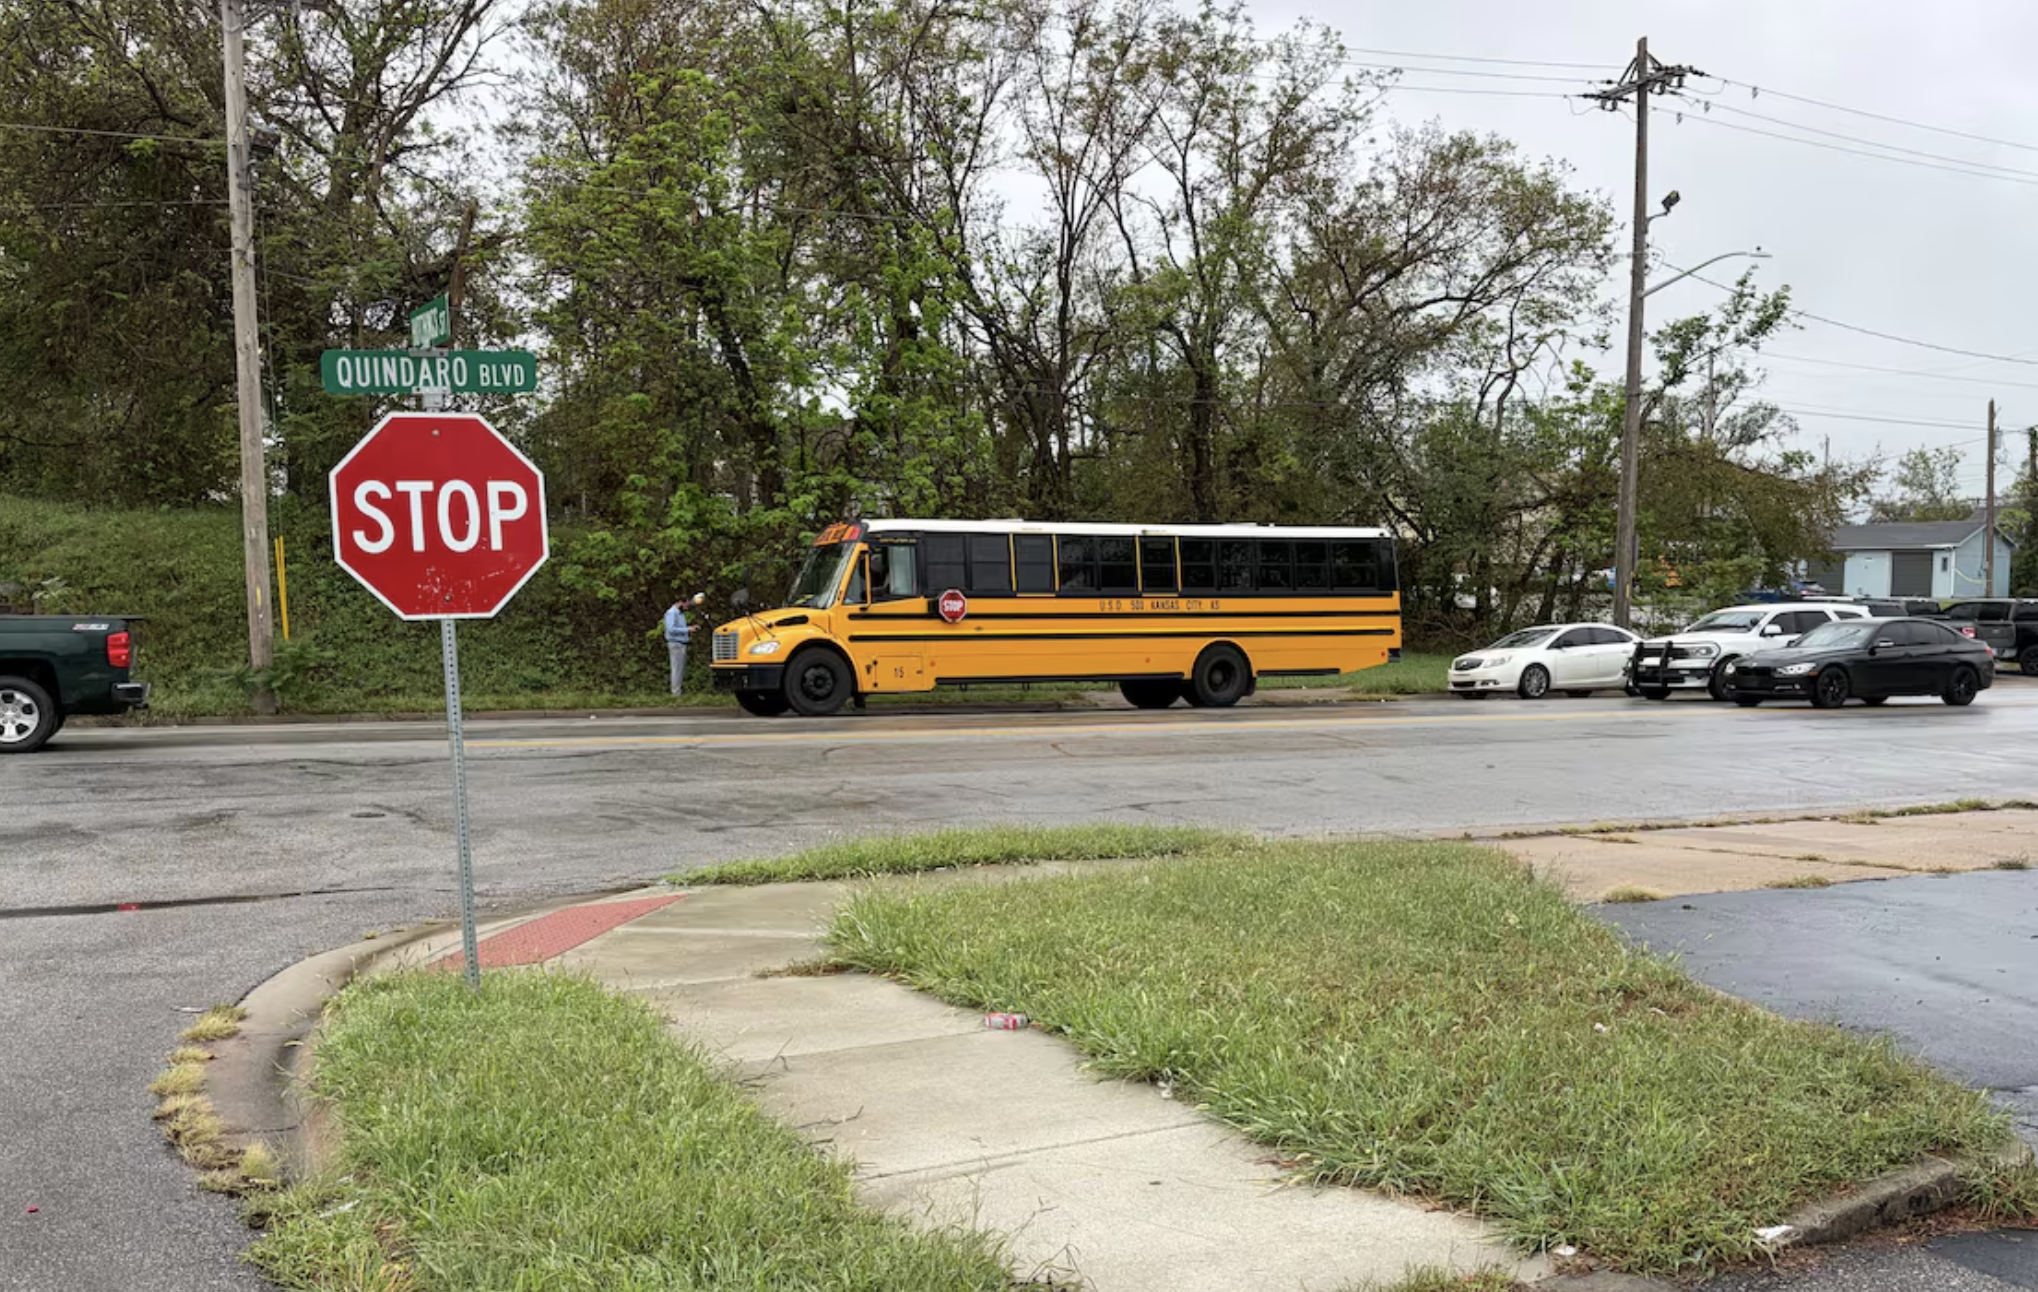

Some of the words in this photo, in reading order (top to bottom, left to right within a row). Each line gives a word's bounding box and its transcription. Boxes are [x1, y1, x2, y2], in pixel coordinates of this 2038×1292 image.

[336, 357, 468, 388] QUINDARO
[479, 364, 525, 387] BLVD
[352, 479, 528, 554] STOP
[942, 599, 964, 612] STOP
[1150, 599, 1180, 610] KANSAS
